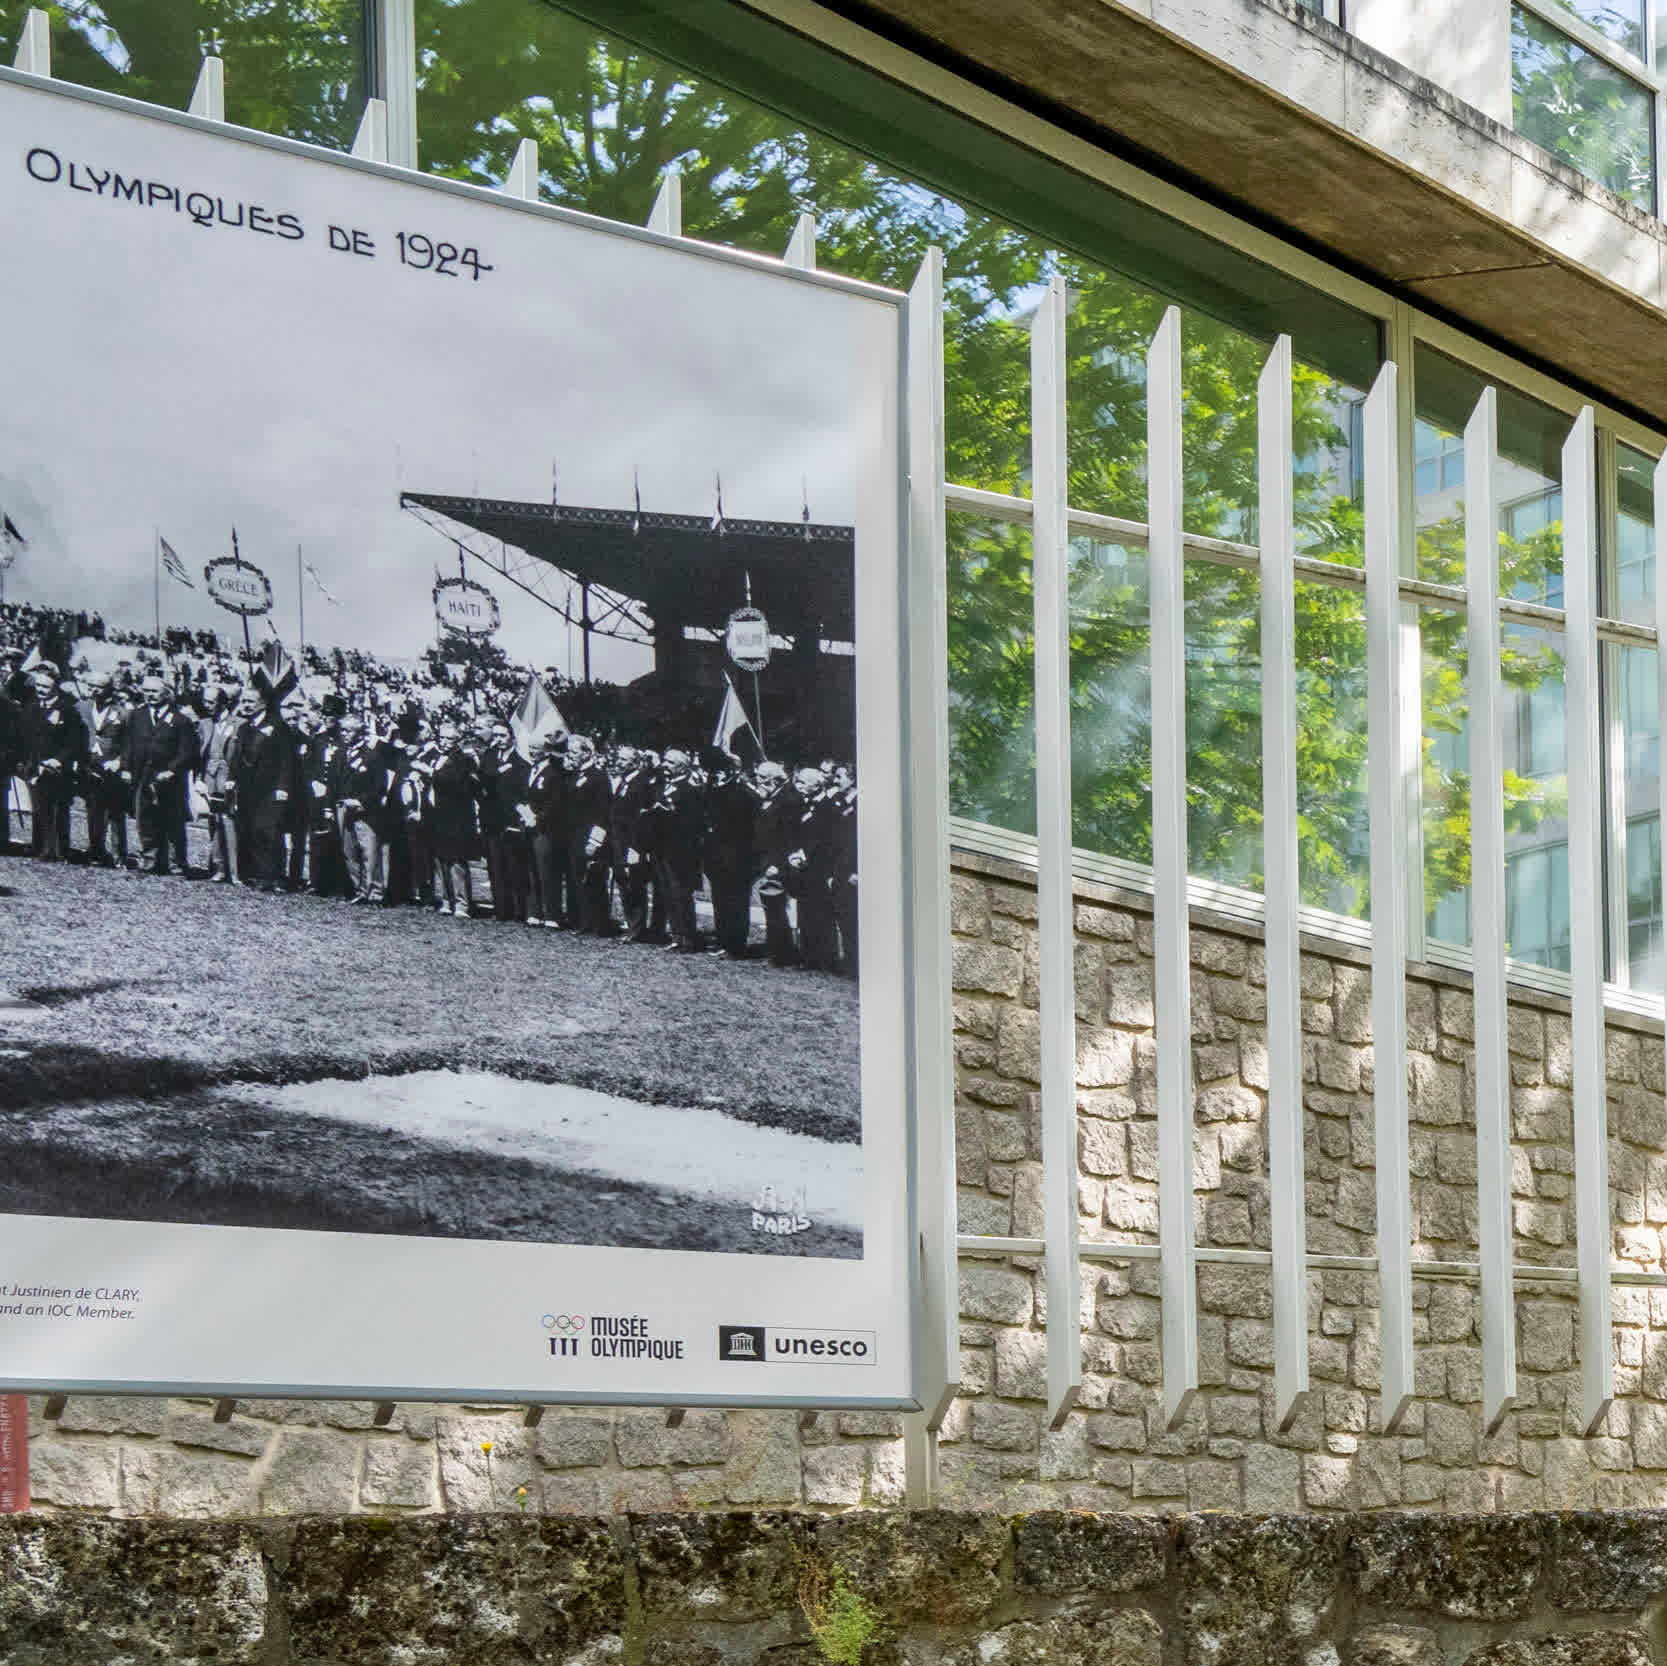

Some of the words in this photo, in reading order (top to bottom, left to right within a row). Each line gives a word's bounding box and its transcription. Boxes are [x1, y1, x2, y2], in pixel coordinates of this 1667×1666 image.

[26, 147, 305, 241] OLYMPIQUES
[328, 223, 376, 258] DE
[395, 231, 494, 281] 1924
[752, 1211, 812, 1236] PARIS
[10, 1284, 71, 1299] Justinien
[75, 1288, 92, 1300] de
[95, 1288, 142, 1303] CLARY,
[25, 1306, 44, 1316] an
[48, 1305, 73, 1317] IOC
[76, 1305, 136, 1320] Member.
[591, 1315, 649, 1338] MUSÉE
[591, 1337, 684, 1361] OLYMPIQUE
[774, 1336, 868, 1357] unesco
